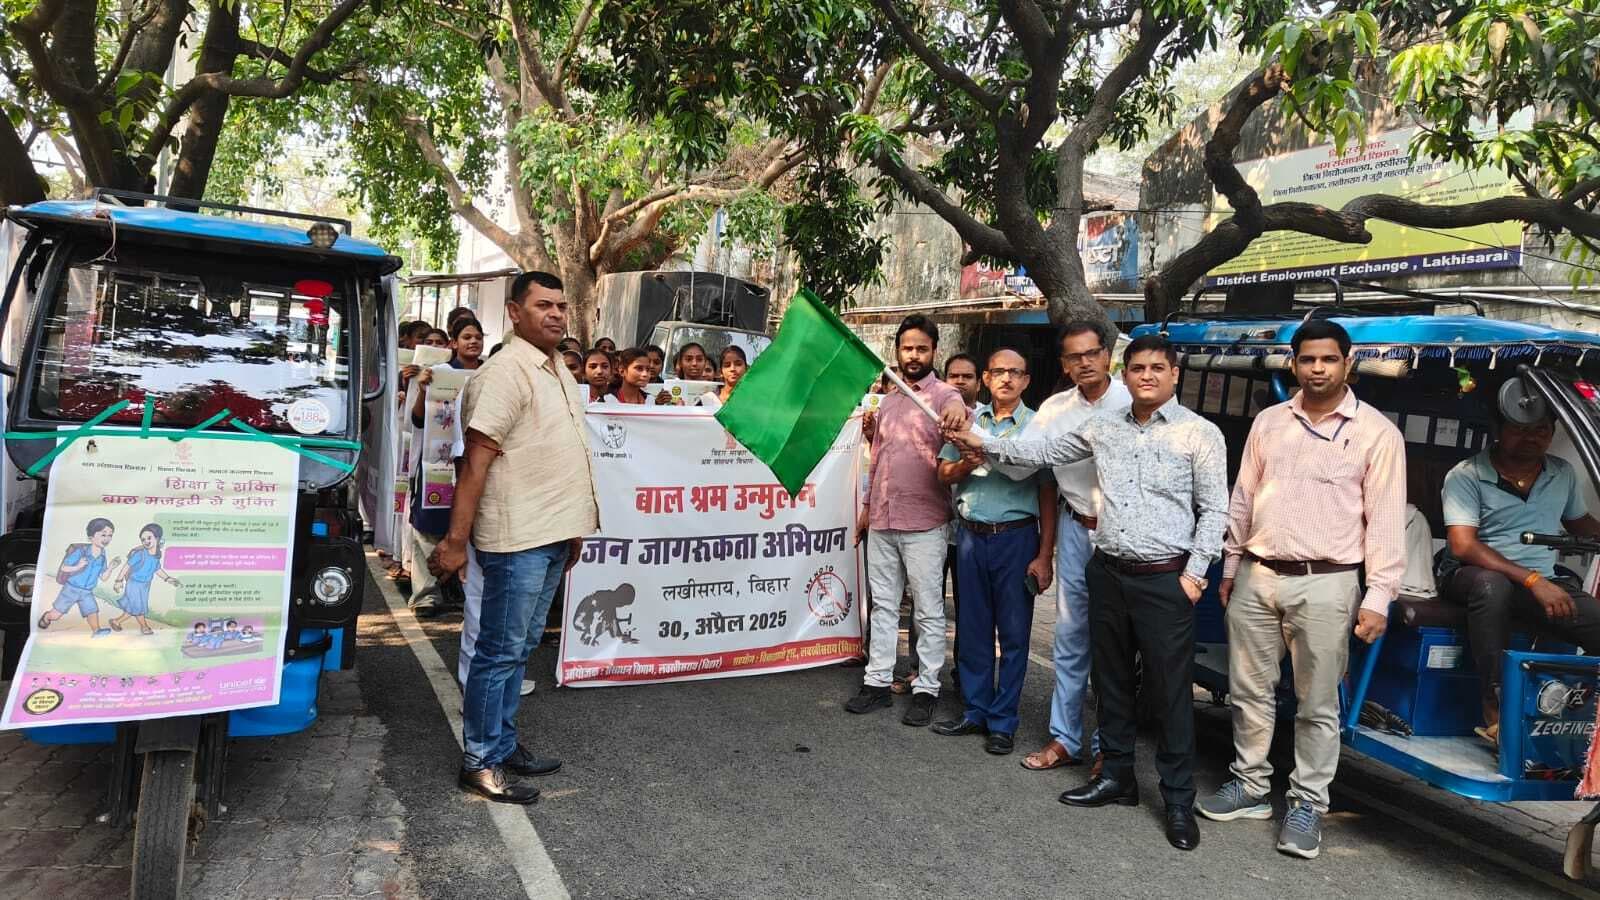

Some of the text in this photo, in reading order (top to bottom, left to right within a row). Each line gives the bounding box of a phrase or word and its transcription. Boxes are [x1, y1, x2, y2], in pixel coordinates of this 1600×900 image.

[1216, 274, 1257, 286] District
[1260, 268, 1336, 283] Employment
[1339, 261, 1409, 275] Exchange
[1422, 251, 1510, 268] Lakhisarai
[166, 476, 209, 491] शिक्षा
[232, 479, 279, 493] शक्ति
[102, 494, 139, 505] बाल
[210, 495, 224, 506] से
[231, 496, 276, 510] मुक्ति
[635, 486, 685, 514] बाल
[690, 485, 729, 513] श्रम
[581, 523, 847, 566] जन जागरूकता अभियान
[661, 574, 791, 601] लखीसराय, बिहार
[694, 610, 745, 635] अप्रैल
[748, 610, 788, 630] 2025
